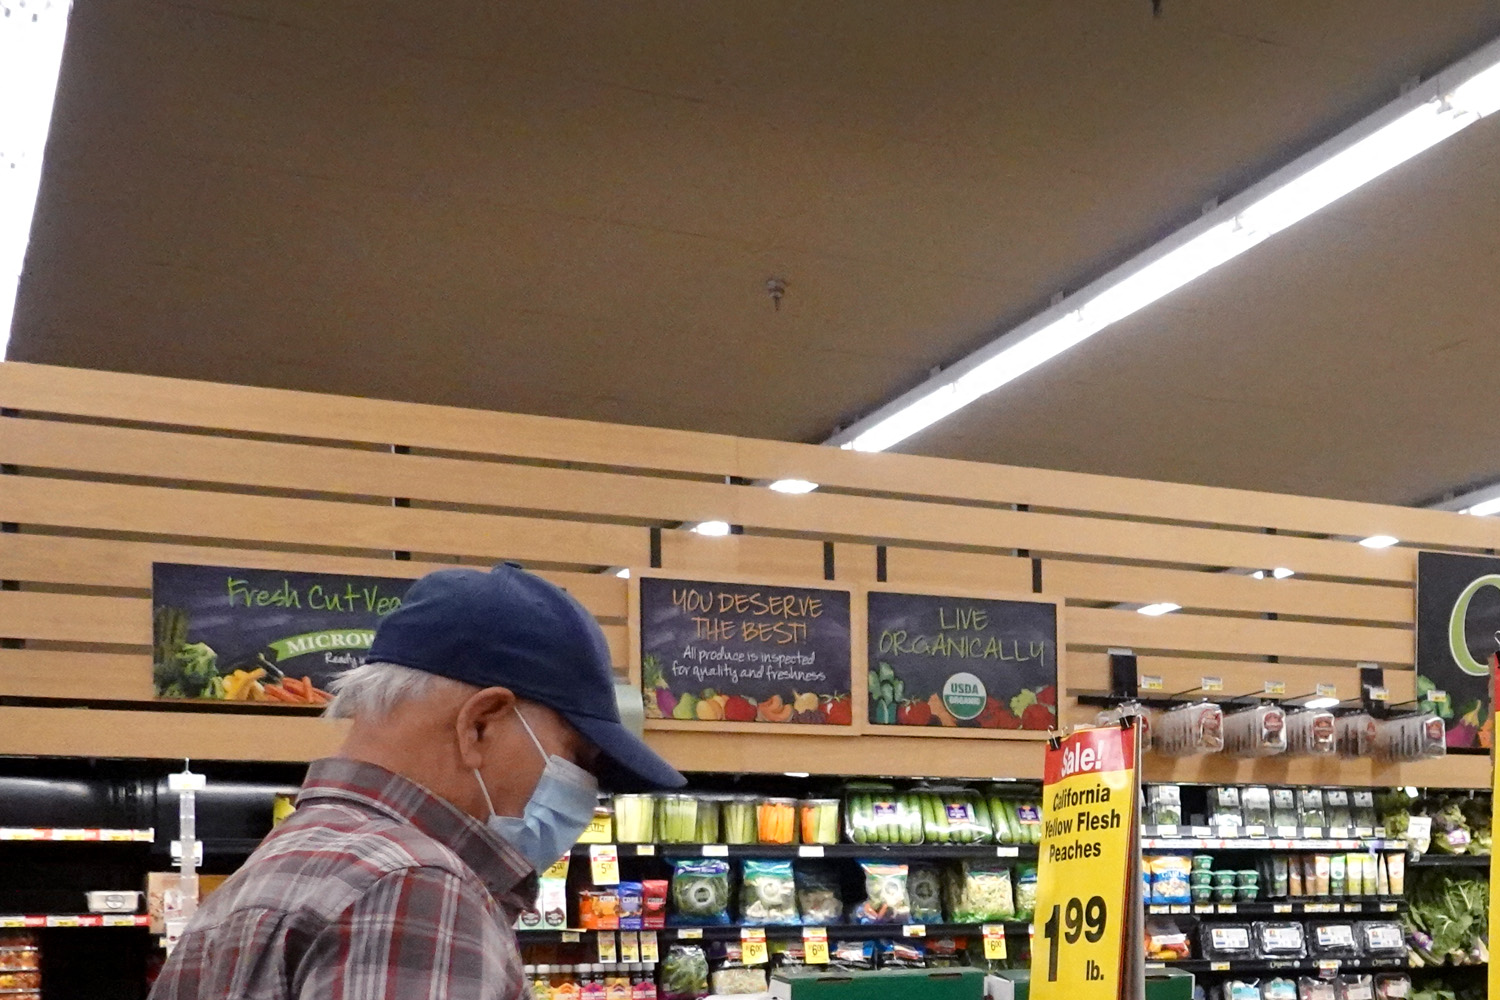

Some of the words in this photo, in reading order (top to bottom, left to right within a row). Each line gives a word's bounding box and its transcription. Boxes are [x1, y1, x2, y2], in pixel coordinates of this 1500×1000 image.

[227, 577, 300, 608] Fresh
[308, 584, 363, 611] Cut
[673, 588, 717, 613] YOU
[718, 592, 824, 618] DESERVE
[692, 616, 734, 641] THE
[741, 621, 808, 646] BEST!
[940, 607, 989, 632] LIVE
[683, 645, 698, 661] All
[699, 650, 746, 668] produce
[747, 652, 759, 665] is
[760, 651, 816, 671] inspected
[878, 630, 1046, 668] ORGANICALLY
[672, 660, 691, 677] for
[692, 661, 738, 685] quality
[739, 664, 764, 681] and
[765, 664, 827, 684] freshness
[950, 683, 979, 695] USDA
[1061, 740, 1106, 779] Sale!
[1053, 783, 1111, 812] California
[1045, 817, 1073, 839] Yellow
[1077, 808, 1121, 833] Flesh
[1049, 840, 1102, 864] Peaches
[1085, 959, 1105, 982] lb.
